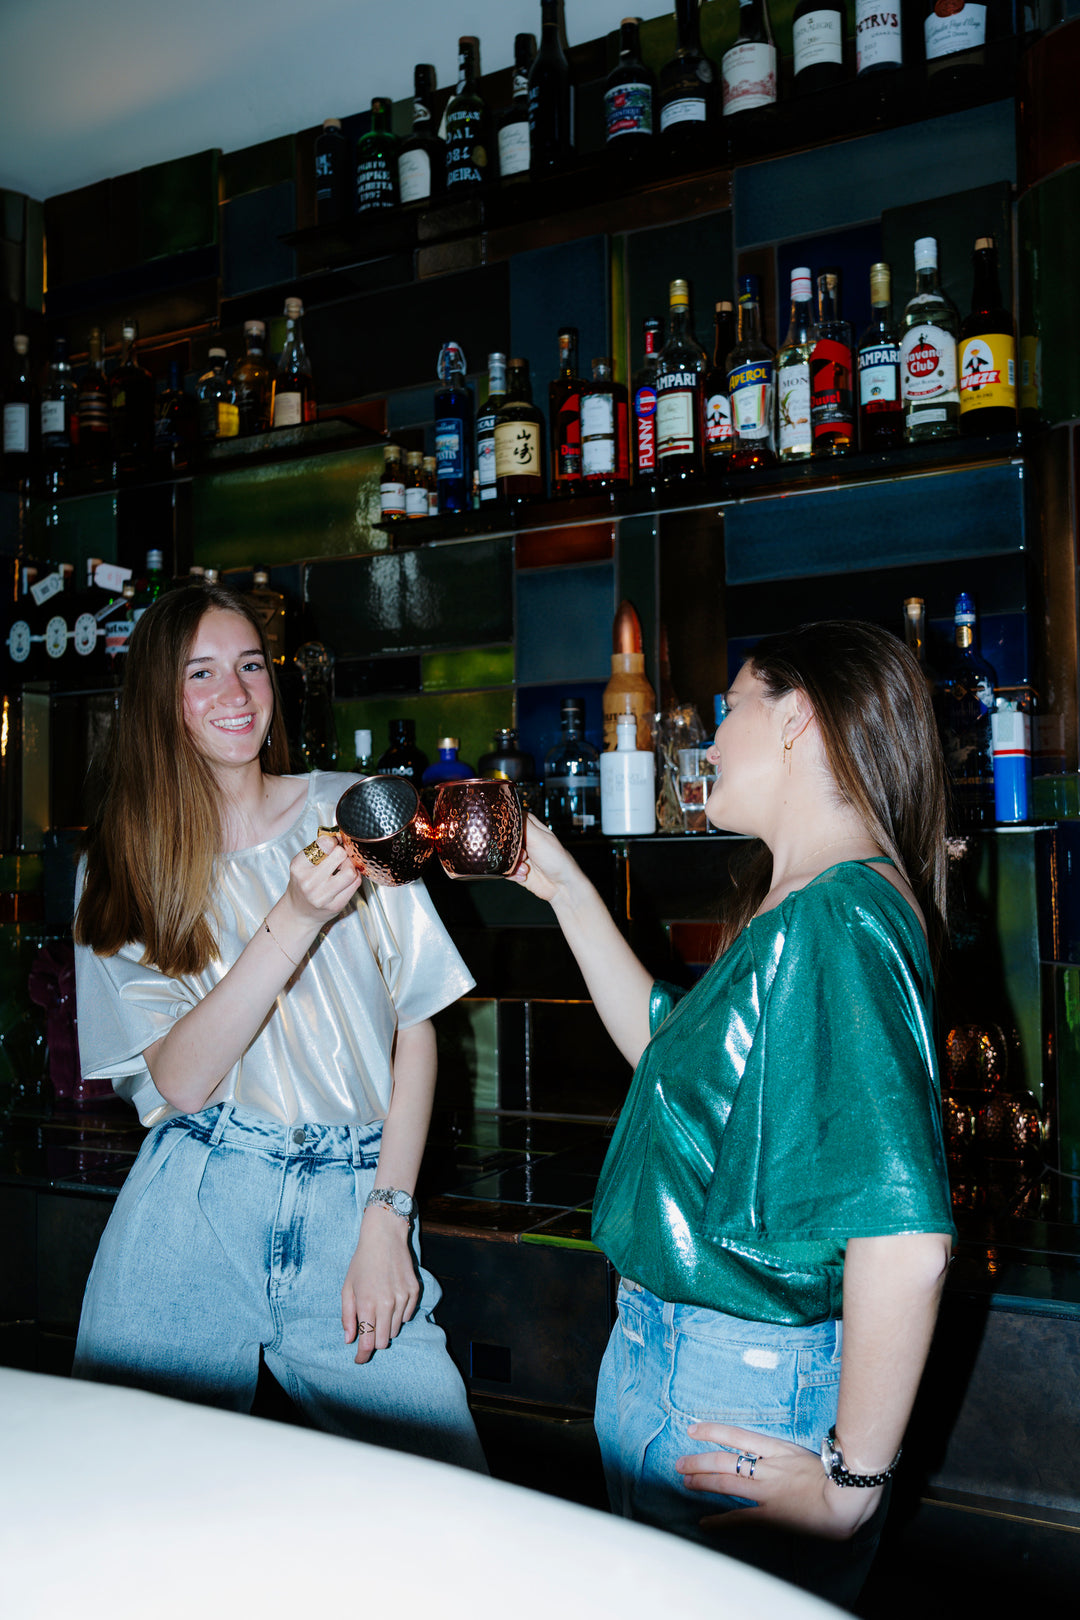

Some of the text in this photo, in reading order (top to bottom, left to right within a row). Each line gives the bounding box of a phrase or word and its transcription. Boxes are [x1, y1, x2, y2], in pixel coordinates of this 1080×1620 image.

[911, 360, 934, 373] Club
[729, 368, 767, 392] APEROL
[639, 419, 653, 468] FUNNY
